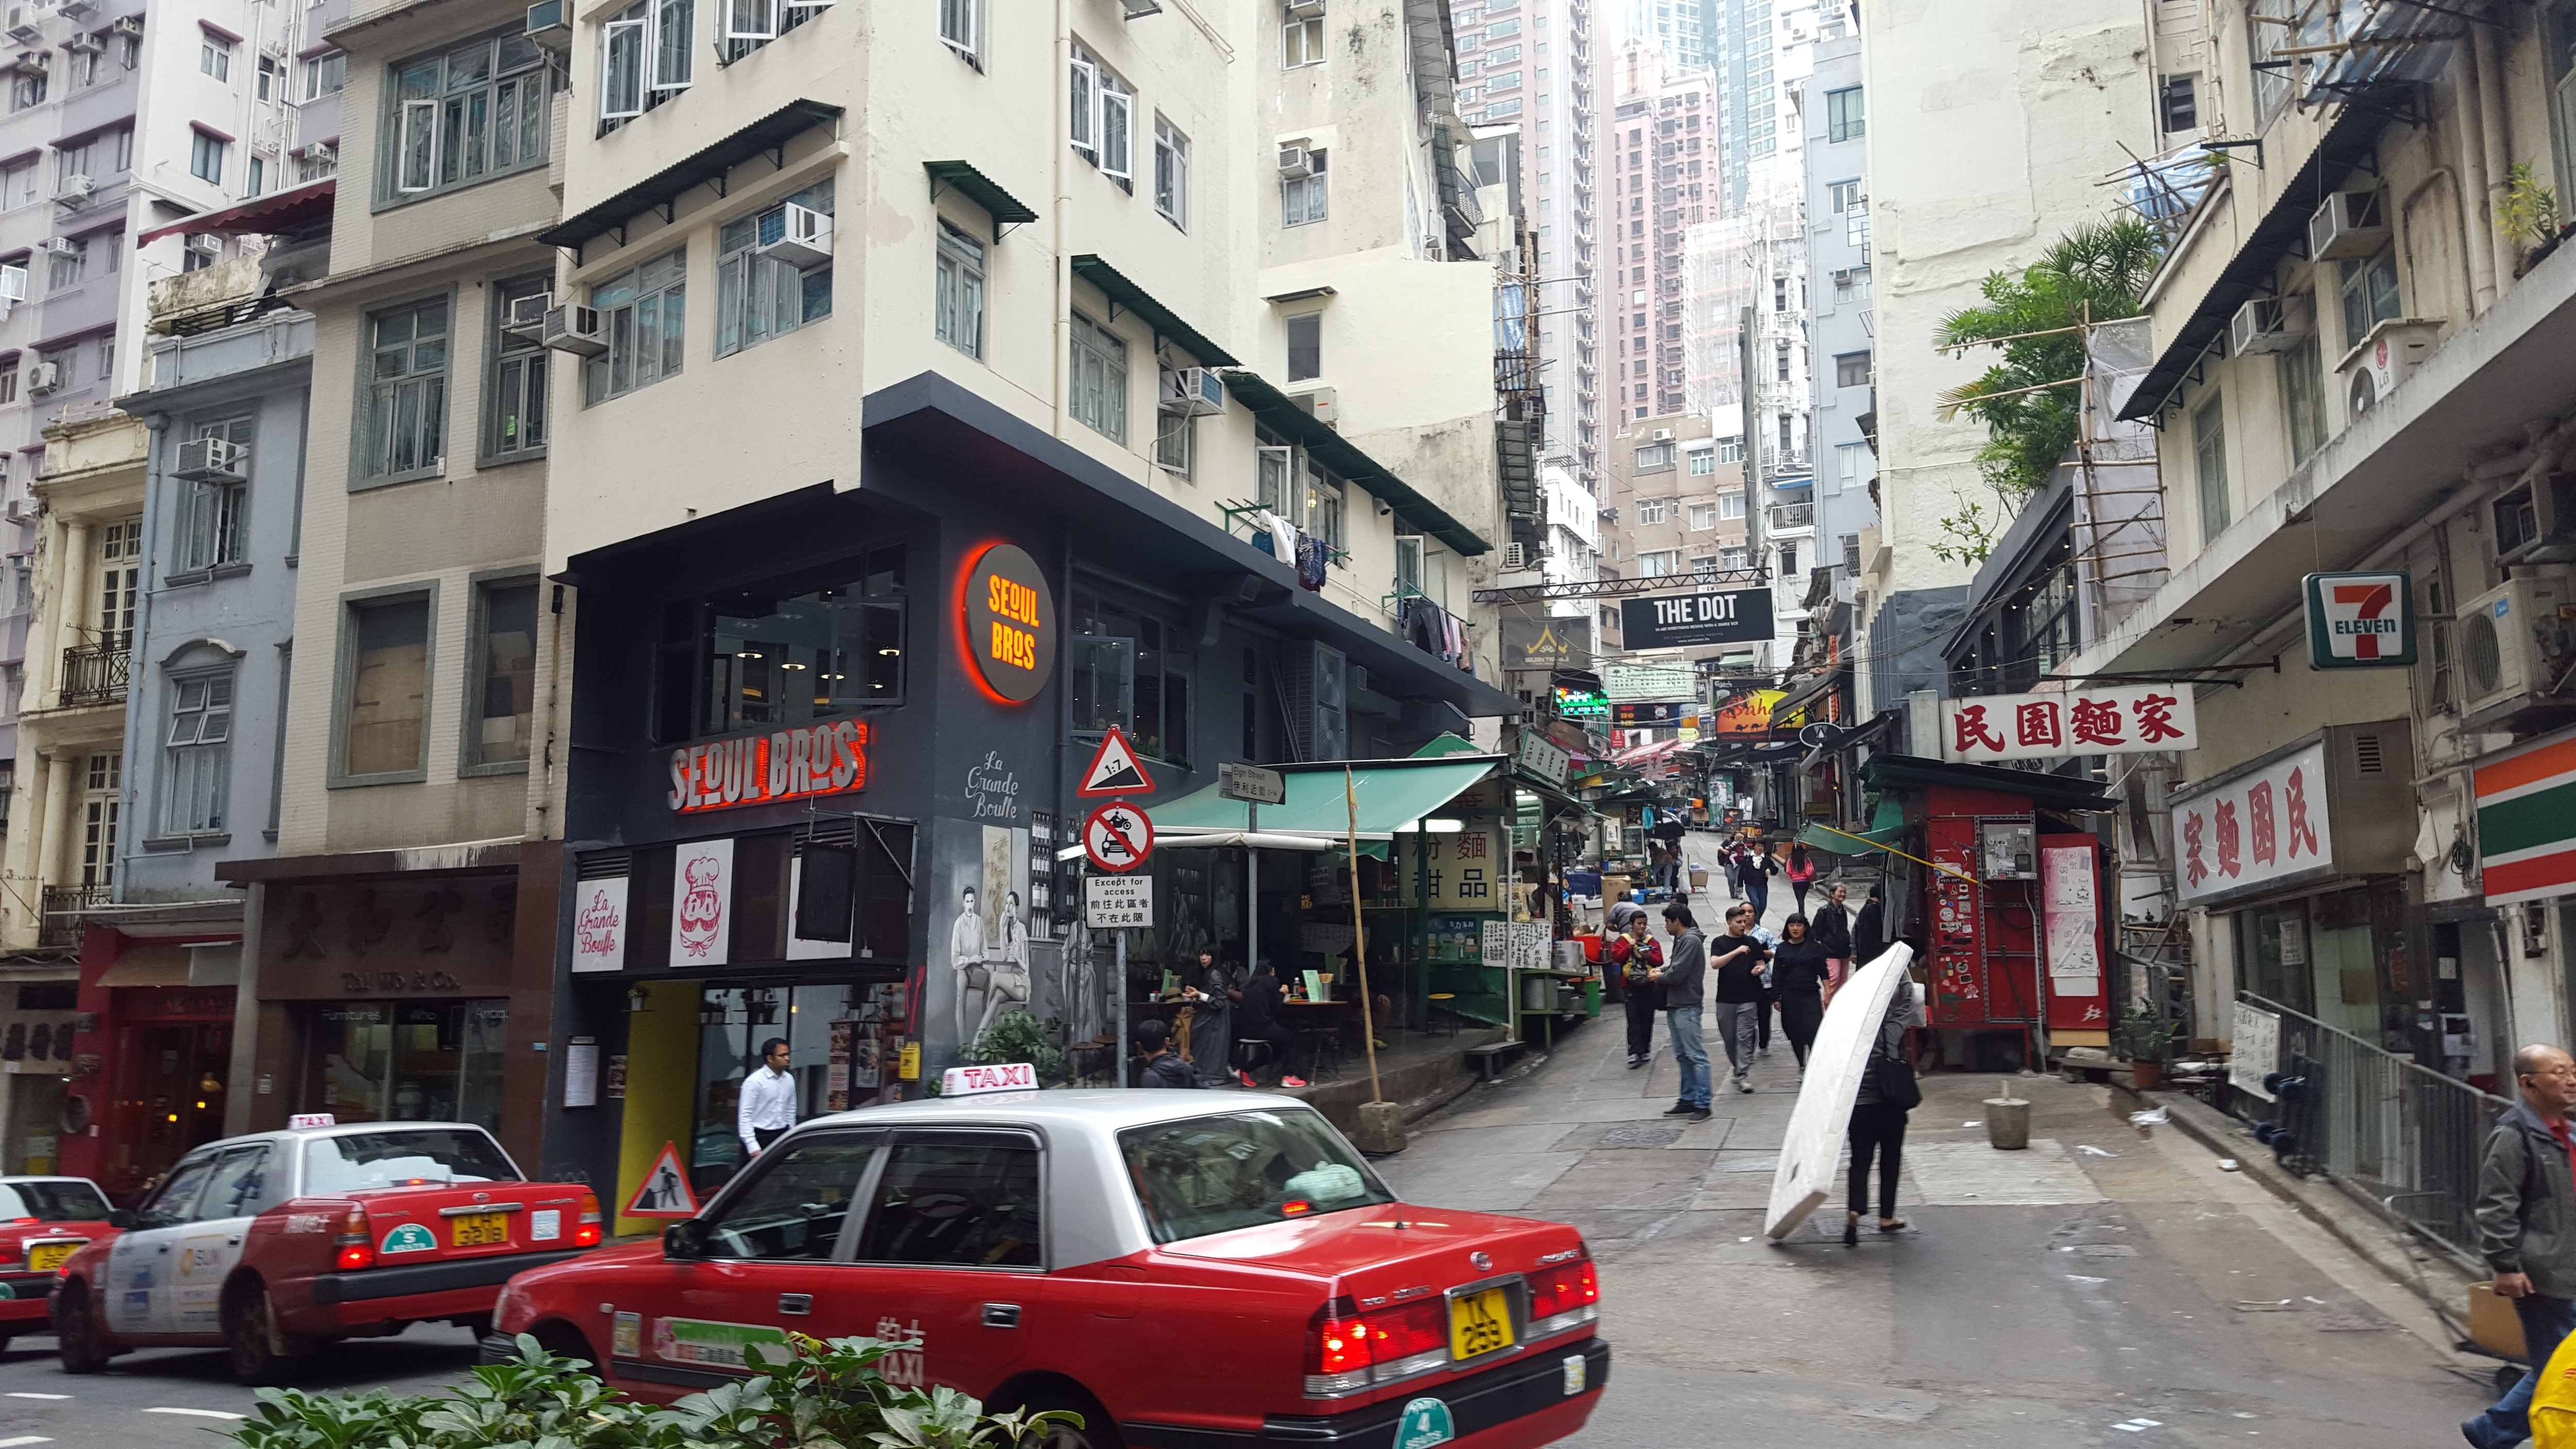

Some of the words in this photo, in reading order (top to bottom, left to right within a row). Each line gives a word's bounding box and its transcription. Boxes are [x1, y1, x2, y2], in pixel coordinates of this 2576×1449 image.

[2379, 371, 2389, 389] LG
[988, 574, 1040, 627] SEOUL
[1653, 598, 1693, 624] THE
[1698, 594, 1737, 621] DOT
[992, 621, 1036, 670] BROS
[1954, 694, 2185, 753] 民園麵家
[668, 737, 762, 810] SEOUL
[770, 721, 859, 796] BROS
[984, 751, 1003, 770] La
[1105, 759, 1122, 775] 1:7
[965, 766, 1018, 798] Grande
[1248, 770, 1265, 780] Street
[1233, 781, 1265, 796] 伊利近街
[1095, 879, 1126, 888] Except
[592, 889, 609, 912] La
[1090, 898, 1149, 910] 前往此區者
[578, 905, 620, 935] Grande
[1096, 913, 1143, 924] 不在此限
[581, 930, 616, 957] Bouffe
[964, 1065, 1030, 1088] TAXI
[298, 1116, 332, 1127] TAXI
[403, 1232, 417, 1243] 5
[878, 1351, 924, 1387] TAXI
